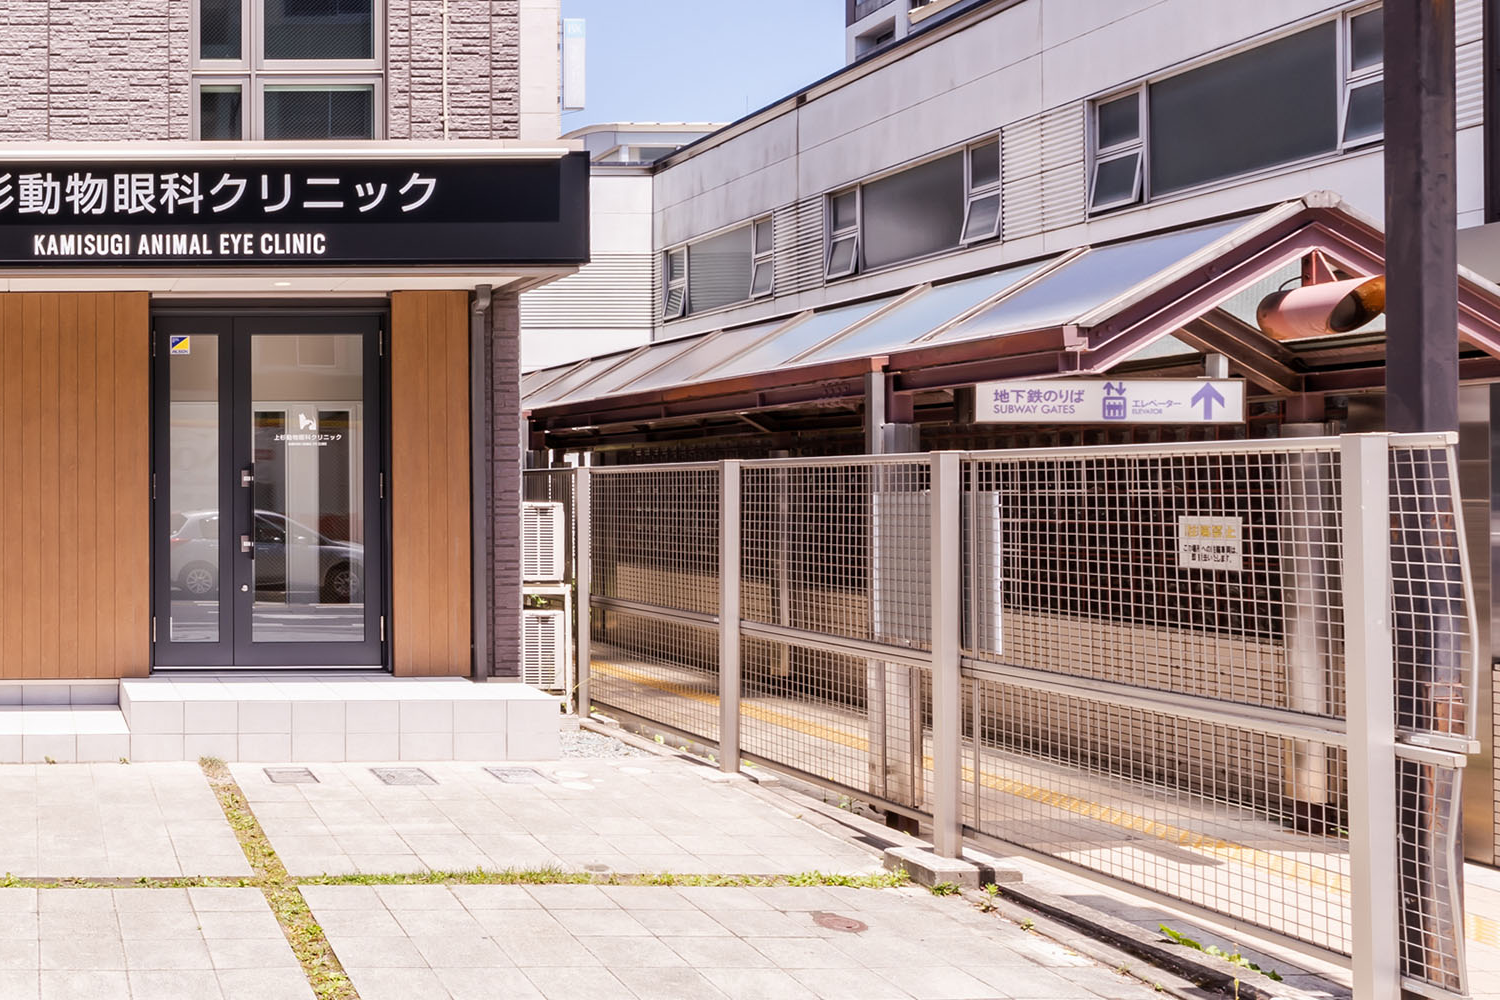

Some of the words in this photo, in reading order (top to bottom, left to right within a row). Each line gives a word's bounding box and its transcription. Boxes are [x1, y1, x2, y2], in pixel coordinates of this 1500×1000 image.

[33, 233, 131, 257] KAMISUGI
[137, 233, 213, 256] ANIMAL
[219, 233, 254, 255] EYE
[260, 233, 327, 255] CLINIC
[993, 389, 1085, 404] 地下鉄のりば
[993, 404, 1038, 414] SUBWAY
[1040, 404, 1076, 414] GATES
